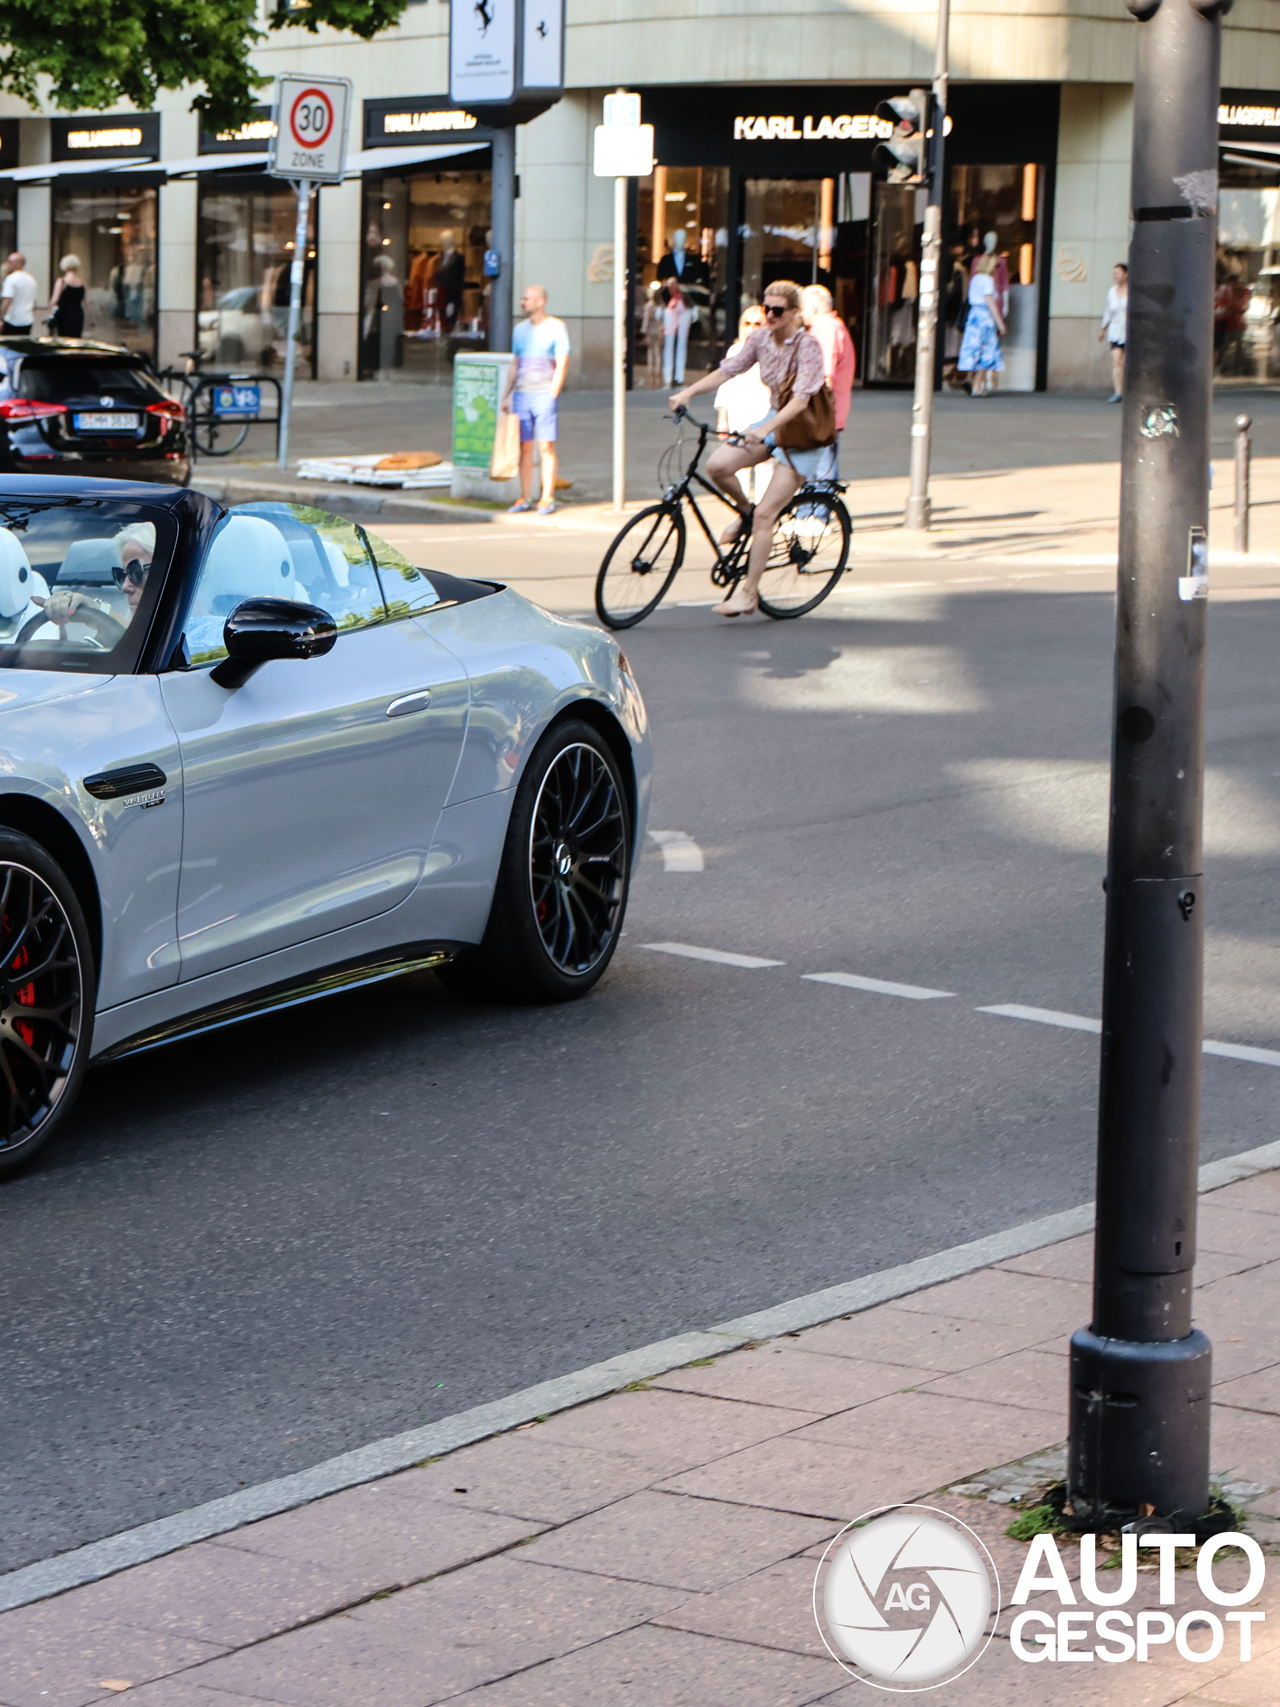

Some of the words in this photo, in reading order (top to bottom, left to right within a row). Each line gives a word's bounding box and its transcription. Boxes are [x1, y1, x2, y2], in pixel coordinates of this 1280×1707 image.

[299, 104, 324, 132] 30
[734, 116, 802, 140] KARL
[803, 115, 953, 140] LAGER
[291, 151, 325, 169] ZONE
